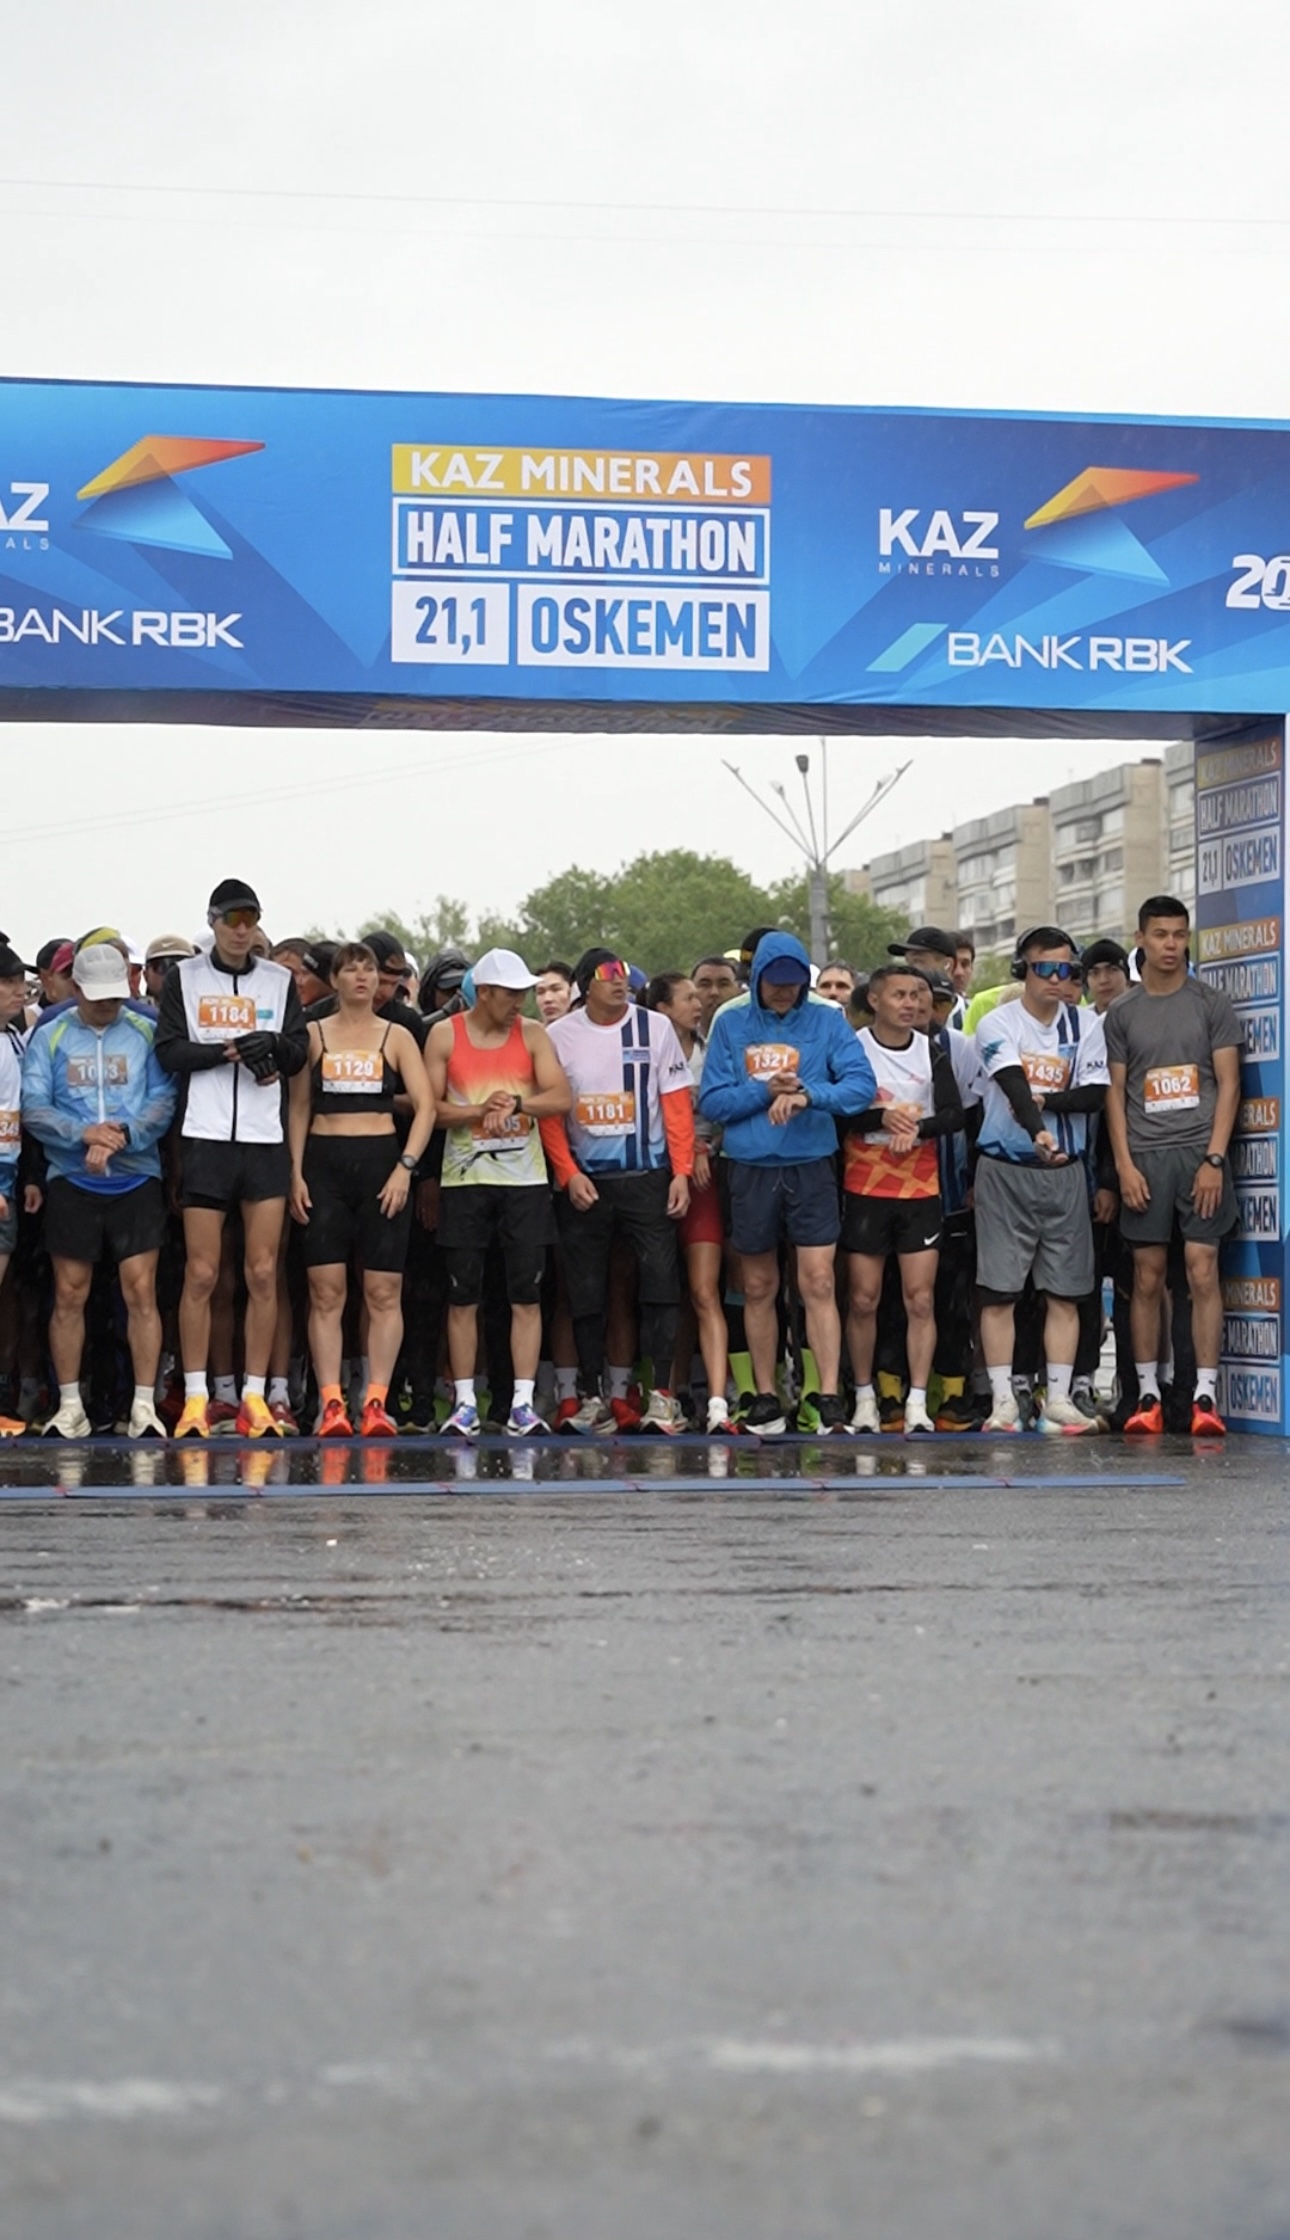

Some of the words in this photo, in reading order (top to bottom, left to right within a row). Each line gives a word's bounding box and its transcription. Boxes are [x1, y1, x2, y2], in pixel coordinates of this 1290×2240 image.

[411, 451, 503, 489] KAZ
[521, 455, 751, 498] MINERALS
[0, 482, 49, 531] Z
[5, 536, 49, 551] ALS
[407, 511, 513, 565] HALF
[527, 514, 755, 572] MARATHON
[879, 508, 999, 559] KAZ
[879, 561, 1000, 578] MINERALS
[132, 611, 245, 648] RBK
[415, 596, 486, 655] 21,1
[530, 597, 756, 659] OSKEMEN
[948, 632, 1084, 670] BANK
[1089, 636, 1194, 674] RBK
[1201, 795, 1222, 831] HALF
[1224, 781, 1277, 825] MARATHON
[1202, 849, 1218, 886] 21,1
[1226, 837, 1278, 881] OSKEMEN
[1202, 932, 1221, 956] KAZ
[1223, 922, 1276, 951] MINERALS
[1225, 962, 1276, 1001] MARATHON
[210, 1005, 249, 1023] 1184
[1240, 1015, 1277, 1056] KEMEN
[78, 1064, 118, 1081] 103
[335, 1060, 374, 1077] 1129
[754, 1053, 789, 1069] 1321
[1027, 1063, 1064, 1083] 1435
[1152, 1075, 1192, 1096] 1062
[503, 1114, 521, 1133] 05
[587, 1103, 624, 1120] 1181
[1243, 1101, 1276, 1127] ERALS
[1240, 1195, 1277, 1233] KEMEN
[1225, 1281, 1276, 1307] MINERALS
[1227, 1320, 1278, 1356] MARATHON
[1230, 1373, 1278, 1413] OSKEMEN
